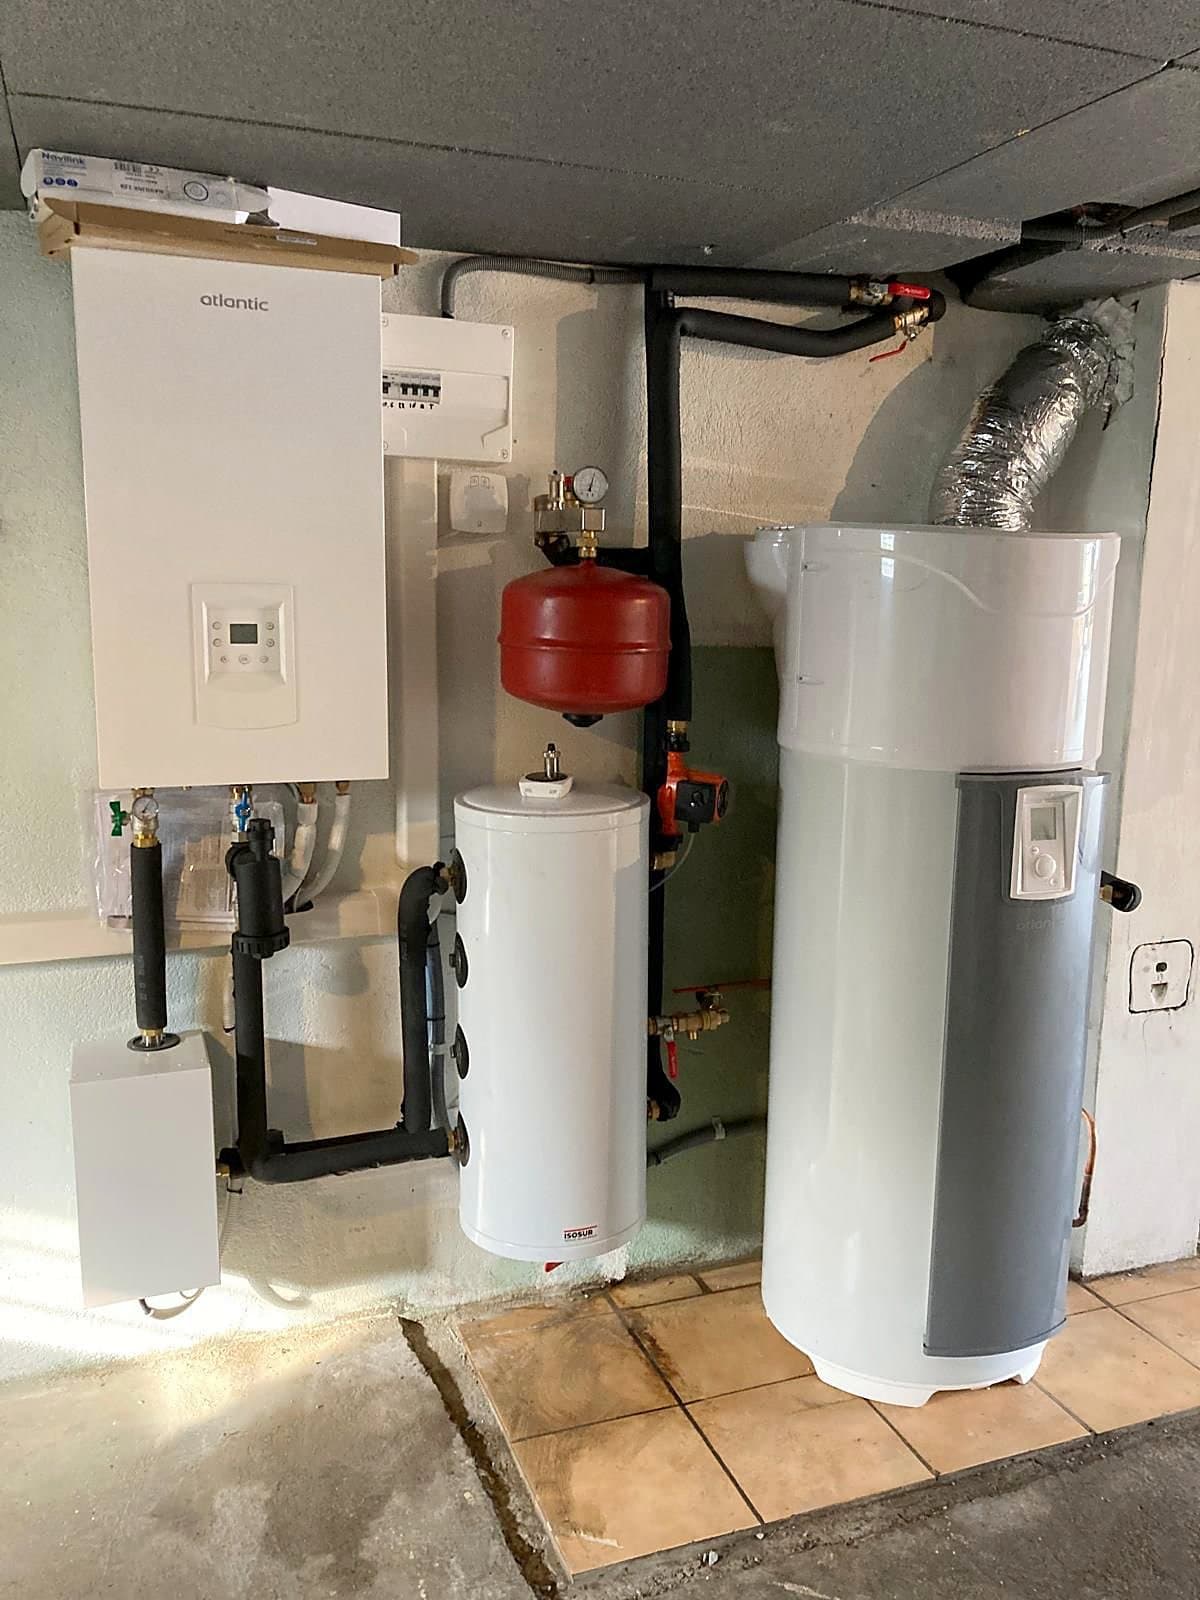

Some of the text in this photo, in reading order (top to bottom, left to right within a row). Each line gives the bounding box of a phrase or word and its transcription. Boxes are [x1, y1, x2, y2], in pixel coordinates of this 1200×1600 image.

[41, 151, 86, 165] Navilink
[200, 294, 269, 311] atlantic
[564, 1230, 593, 1239] ISOSUR
